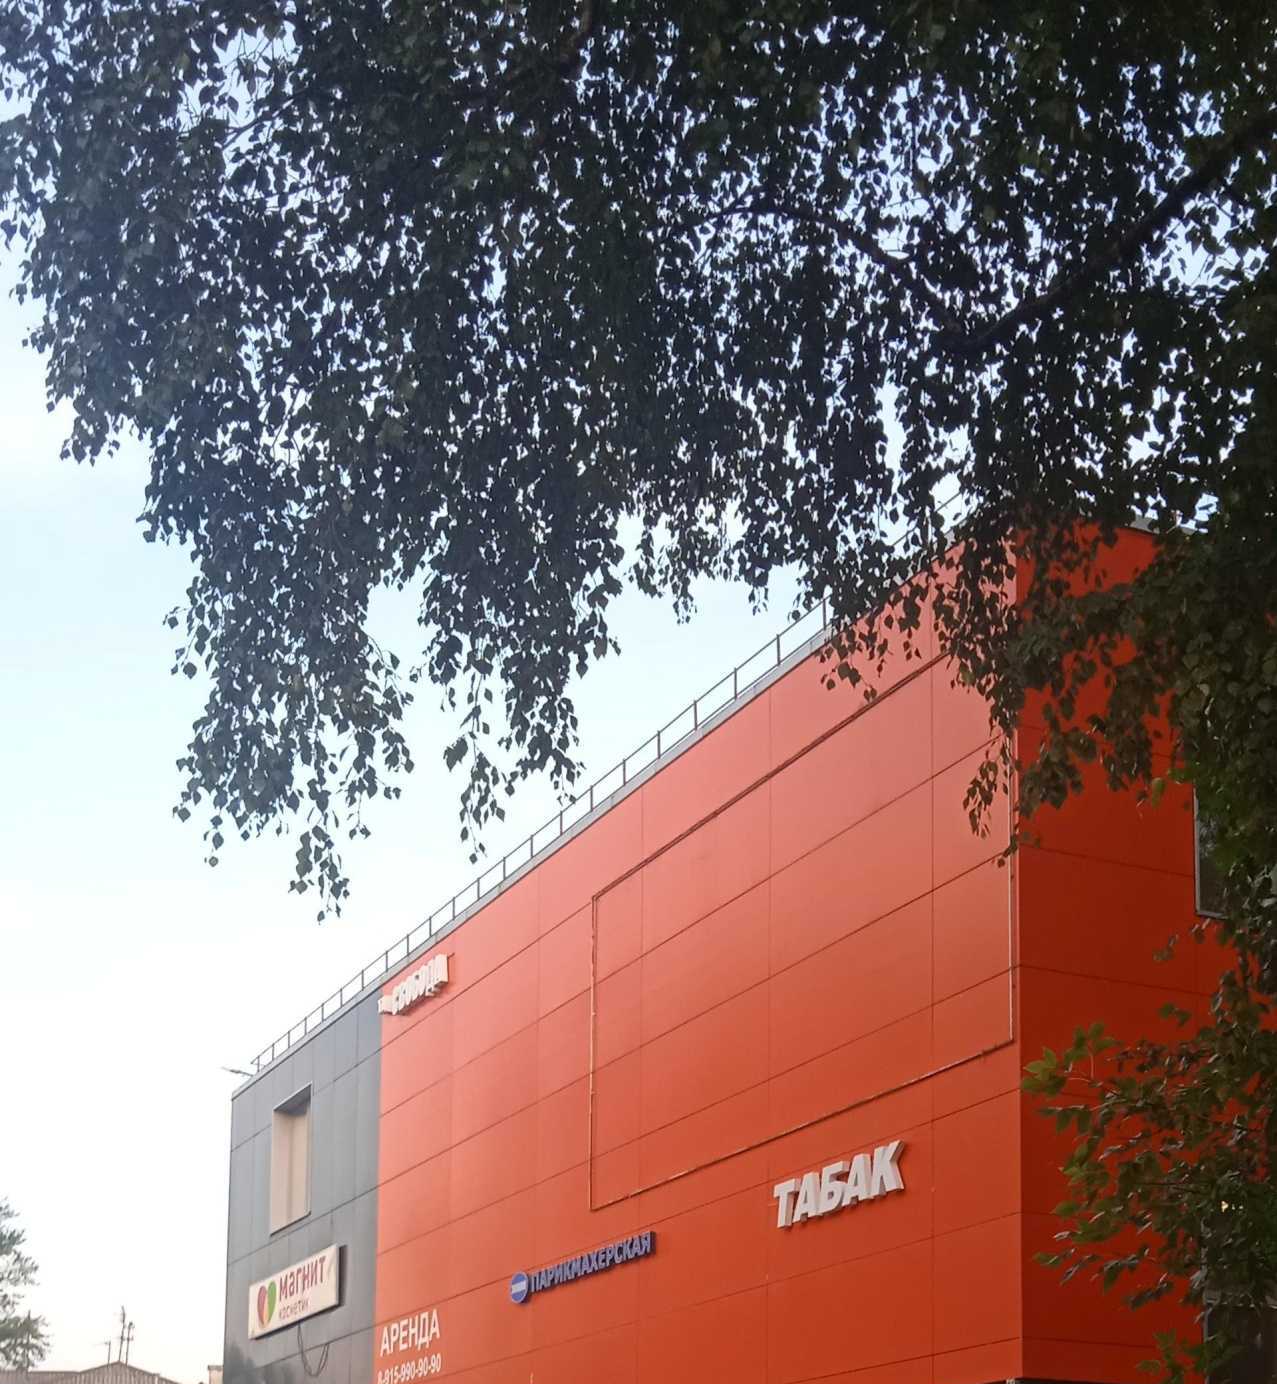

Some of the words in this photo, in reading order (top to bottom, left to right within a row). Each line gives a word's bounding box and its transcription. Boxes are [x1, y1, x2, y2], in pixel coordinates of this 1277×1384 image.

[773, 1140, 905, 1229] ТАБАК
[530, 1231, 656, 1293] ПАРИКМАХЕРСКАЯ
[380, 1309, 440, 1357] АРЕНДА
